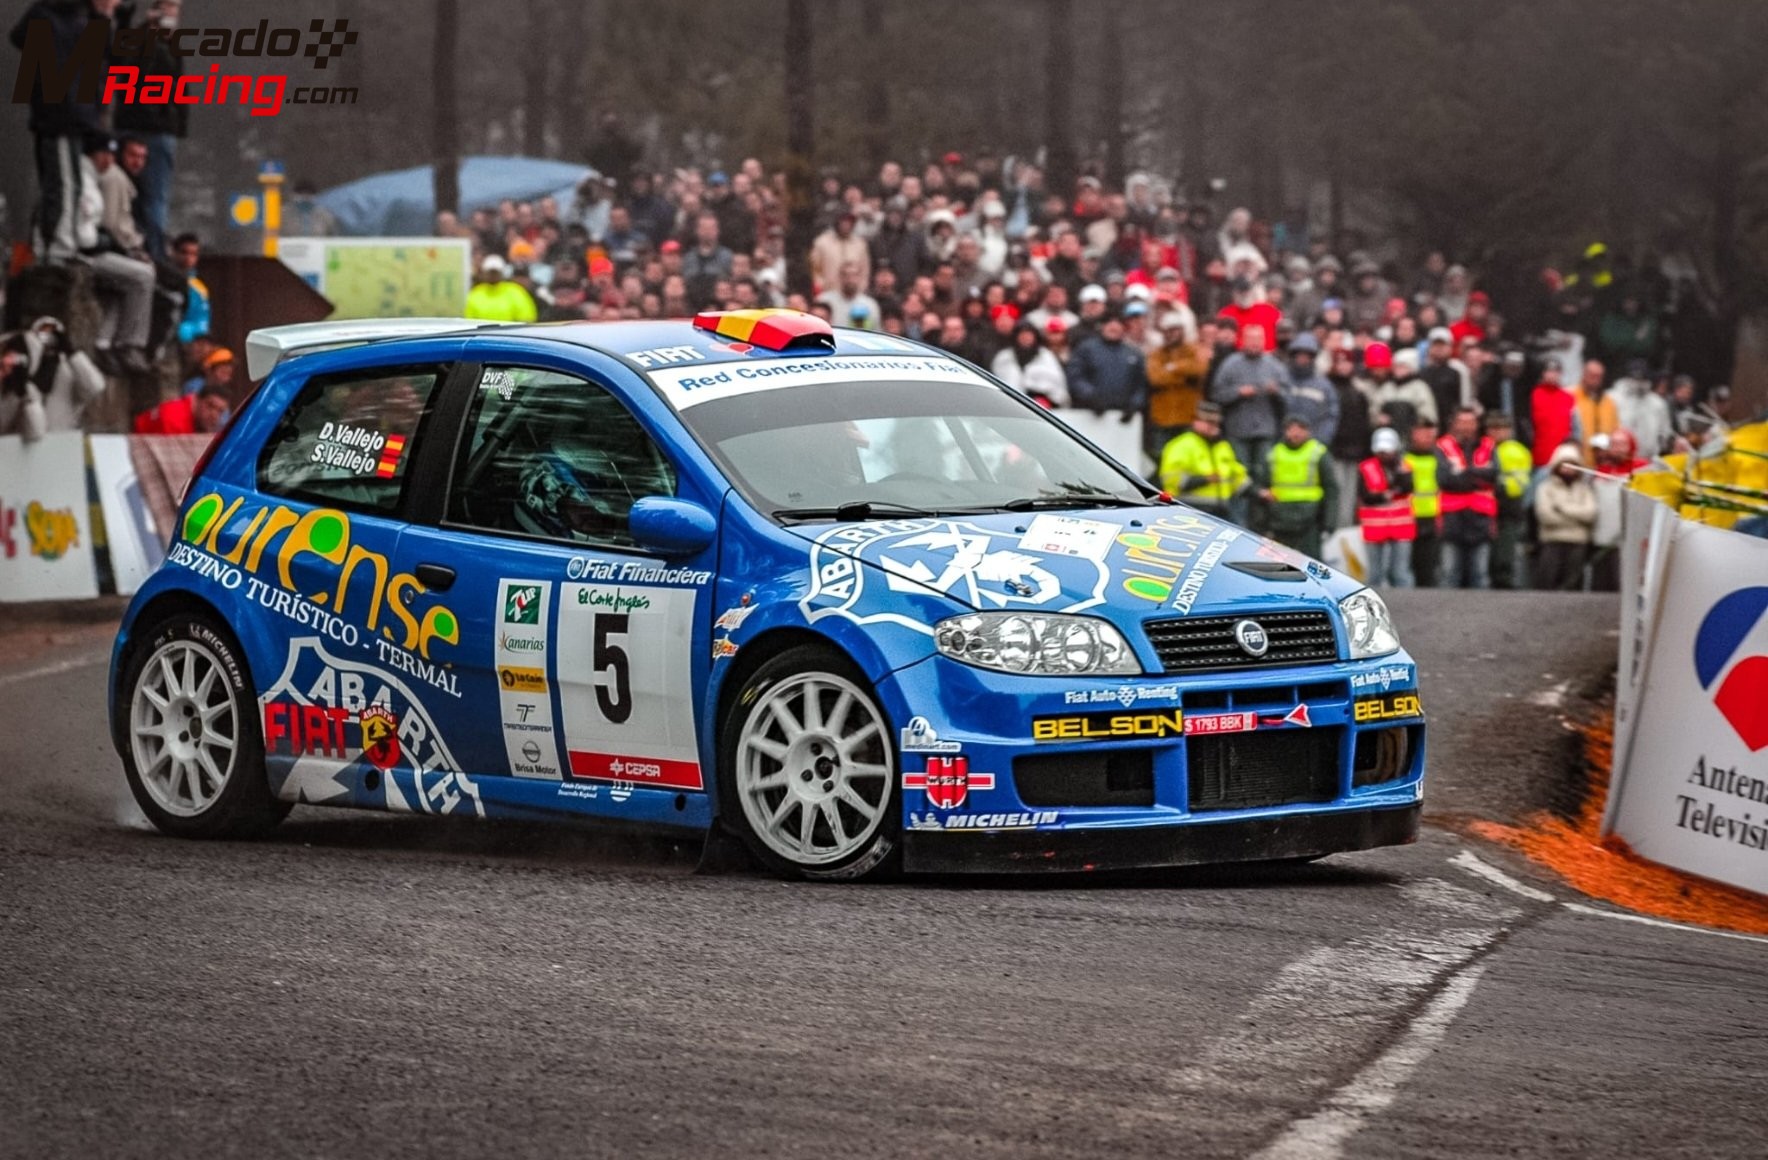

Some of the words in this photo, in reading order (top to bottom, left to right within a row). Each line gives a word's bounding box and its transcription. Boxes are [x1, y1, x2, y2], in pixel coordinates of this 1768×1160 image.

[625, 345, 706, 368] FIAT
[678, 371, 732, 392] Red
[736, 359, 922, 380] Concesionarios
[318, 421, 384, 453] D.Vallejo
[311, 443, 376, 475] S.Vallejo
[581, 559, 618, 580] Fiat
[618, 562, 711, 585] Financiera
[819, 519, 926, 600] ABARTH
[182, 493, 460, 669] ourense
[168, 542, 243, 590] DESTINO
[247, 577, 358, 646] TURÍSTICO
[376, 639, 462, 698] TERMAL
[202, 629, 244, 688] MICHELIN
[594, 613, 632, 724] 5
[1065, 690, 1088, 704] Fiat
[1090, 689, 1117, 702] Auto
[1137, 686, 1178, 700] Renting
[264, 701, 350, 760] FIAT
[363, 707, 393, 723] ABARTH
[1033, 709, 1183, 740] BELSON
[1195, 718, 1218, 731] 1793
[1220, 715, 1242, 729] BBK
[308, 666, 462, 816] ABARTH
[625, 762, 660, 778] CEPSA
[944, 811, 1059, 828] MICHELIN
